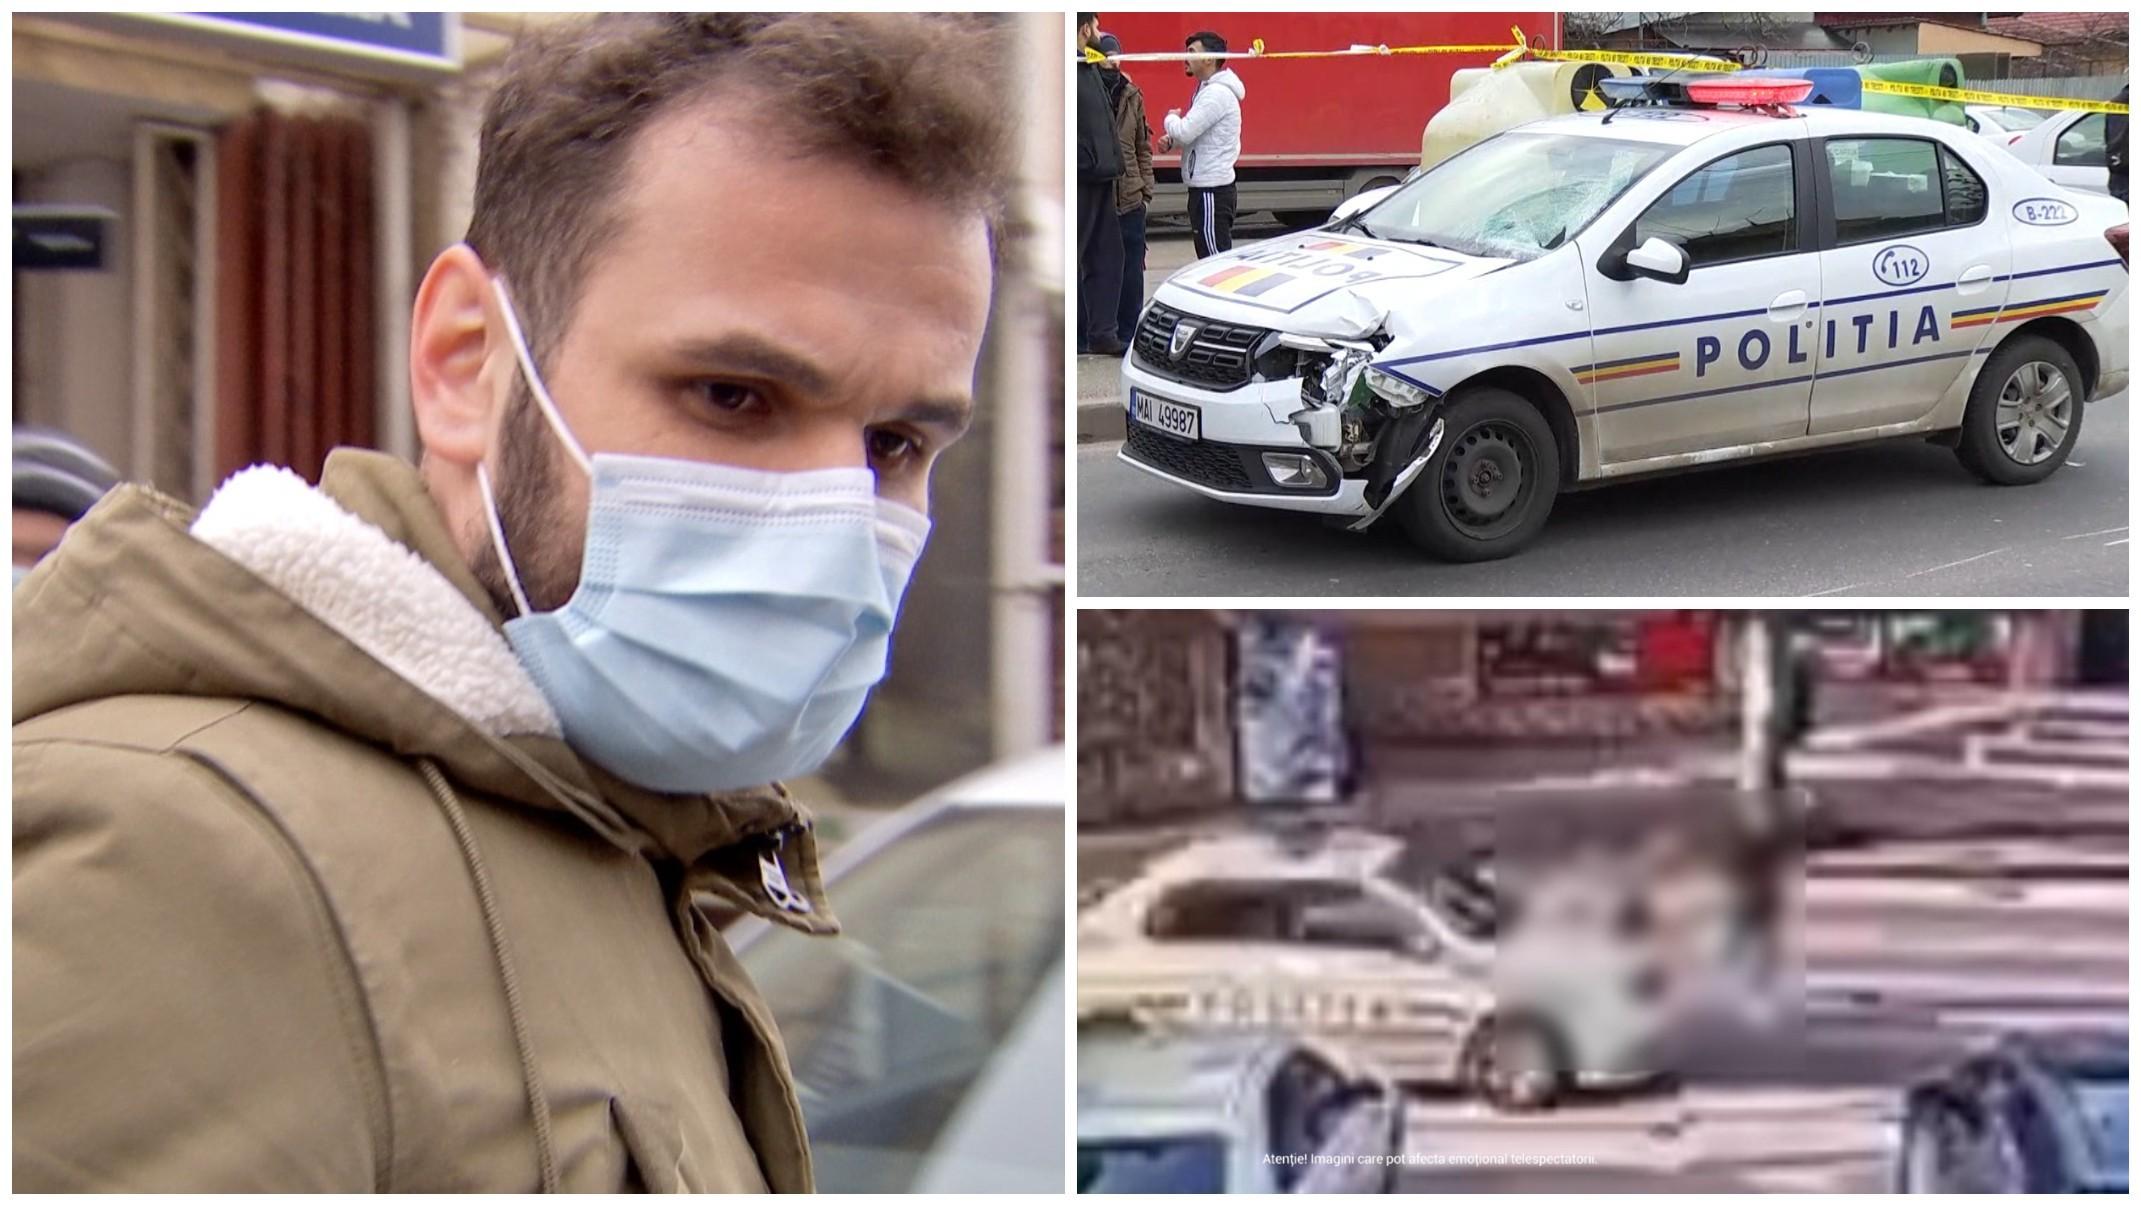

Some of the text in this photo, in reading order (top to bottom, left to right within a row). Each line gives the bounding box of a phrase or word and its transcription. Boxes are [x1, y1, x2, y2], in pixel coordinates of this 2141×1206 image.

[2026, 205, 2067, 220] B-222
[1892, 258, 1920, 279] 112
[1696, 305, 1940, 378] POLITIA
[1136, 395, 1194, 434] MAI 49987
